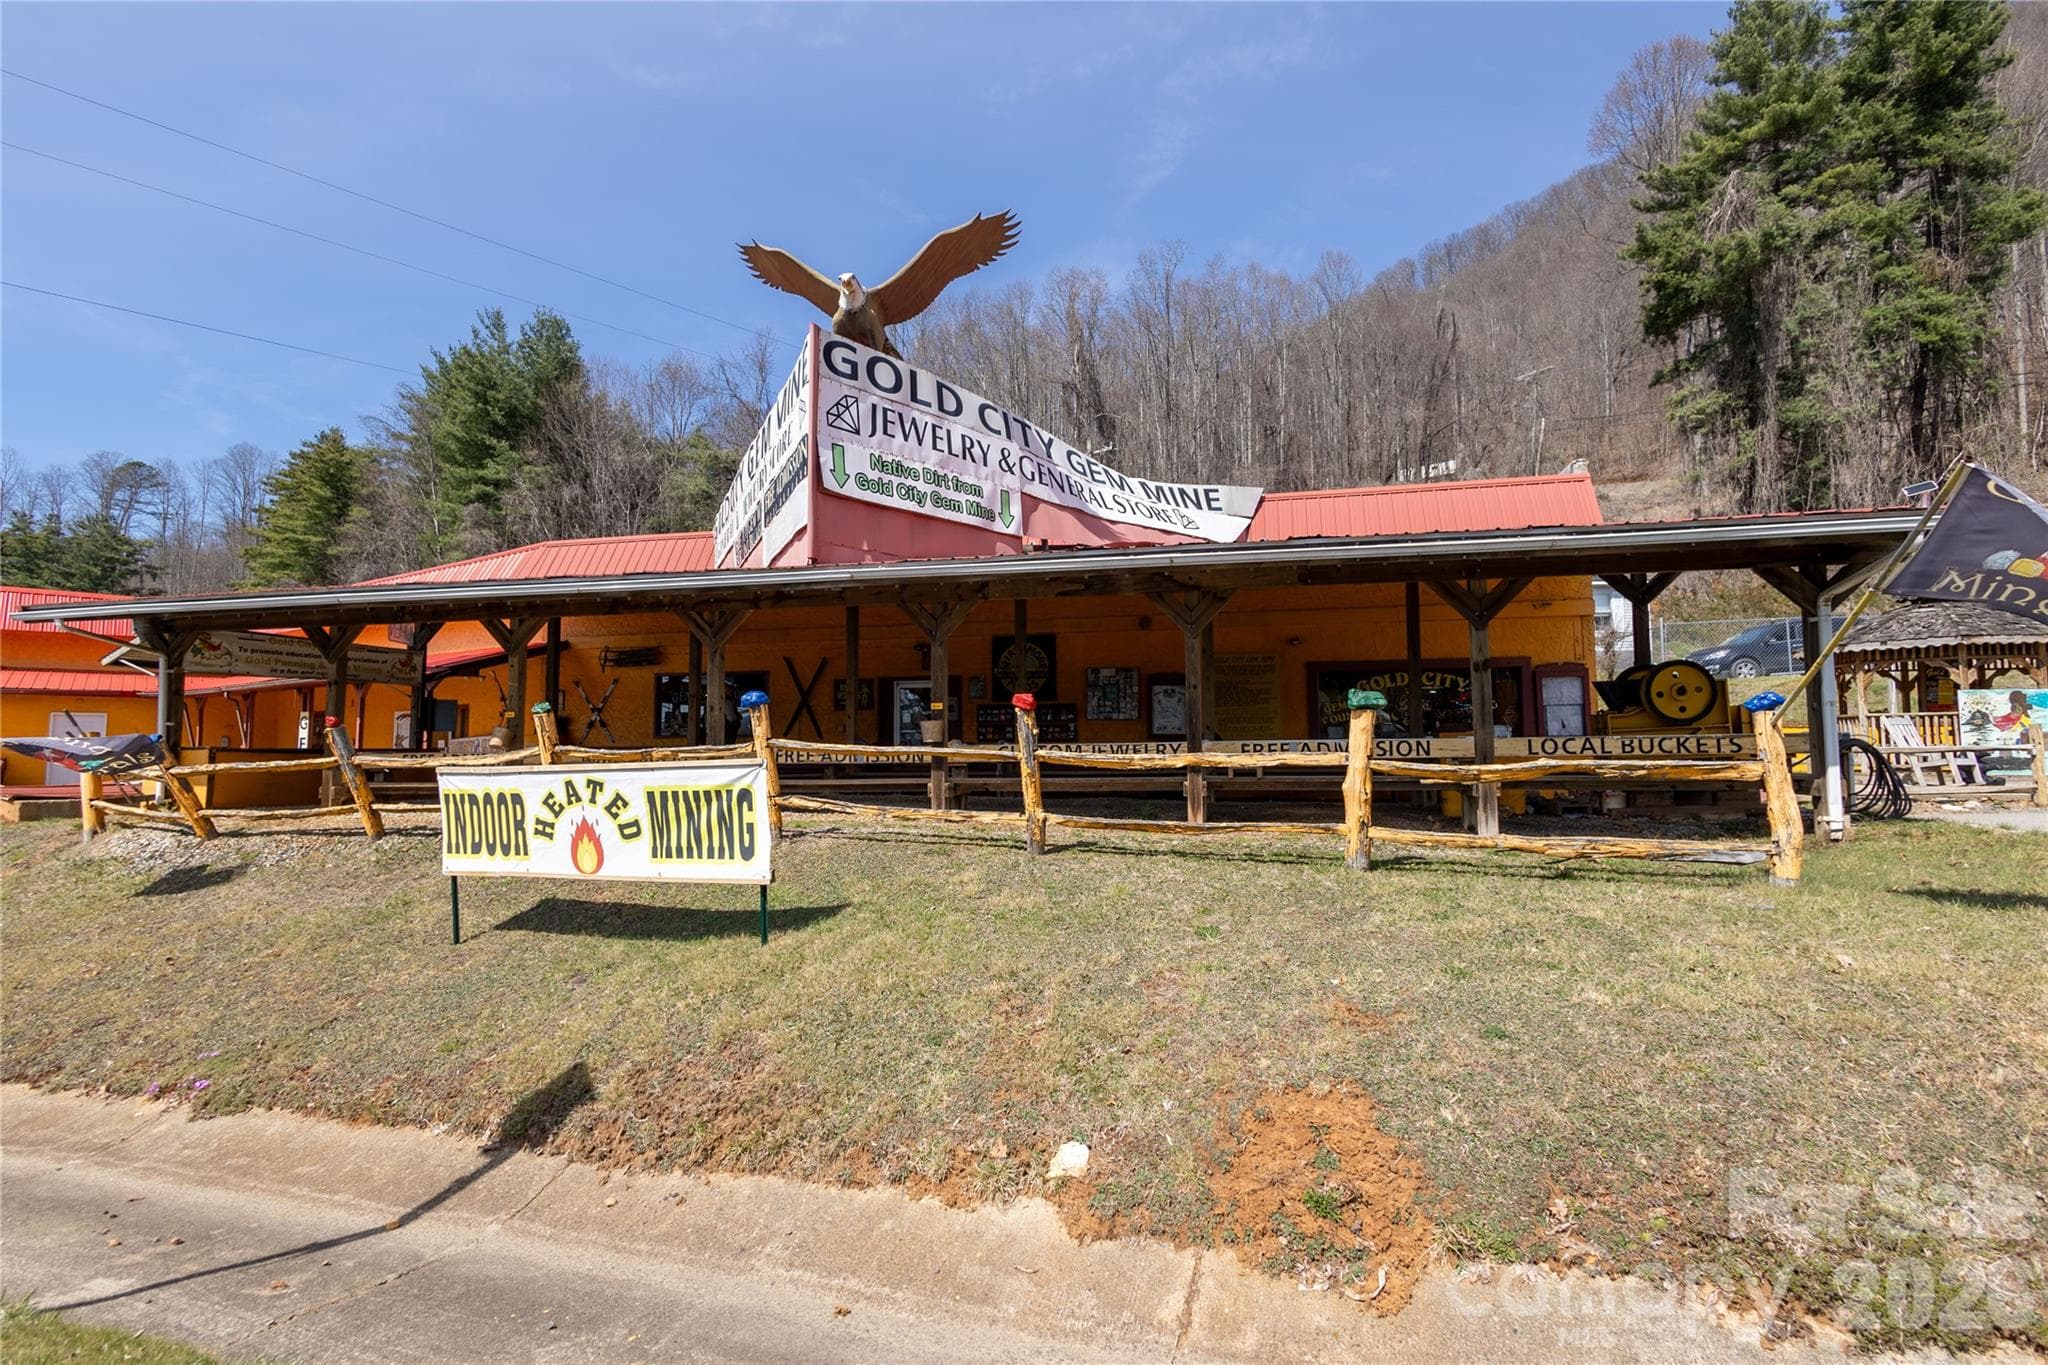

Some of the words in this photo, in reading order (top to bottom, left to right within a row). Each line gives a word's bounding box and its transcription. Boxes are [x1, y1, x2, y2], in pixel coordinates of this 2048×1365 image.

[822, 340, 963, 417] GOLD
[978, 403, 1058, 459] CITY
[1066, 449, 1135, 494] GEM
[1138, 481, 1223, 511] MINE
[869, 403, 990, 467] JEWELRY
[998, 447, 1017, 475] &
[1019, 455, 1113, 510] GENERAL
[1113, 494, 1177, 525] STORE
[870, 453, 920, 481] Native
[923, 467, 950, 489] Dirt
[951, 476, 984, 499] from
[855, 471, 894, 497] Gold
[896, 484, 927, 508] City
[930, 492, 963, 514] Gem
[965, 500, 996, 522] Mine
[1356, 672, 1409, 690] GOLD
[1421, 672, 1472, 692] CITY
[775, 749, 814, 762] FREE
[1241, 743, 1290, 754] FREE
[1300, 740, 1430, 757] ADMSION
[1528, 737, 1612, 755] LOCAL
[1620, 737, 1742, 756] BUCKETS
[444, 791, 529, 858] INDOOR
[533, 778, 643, 841] HEATED
[646, 787, 755, 862] MINING
